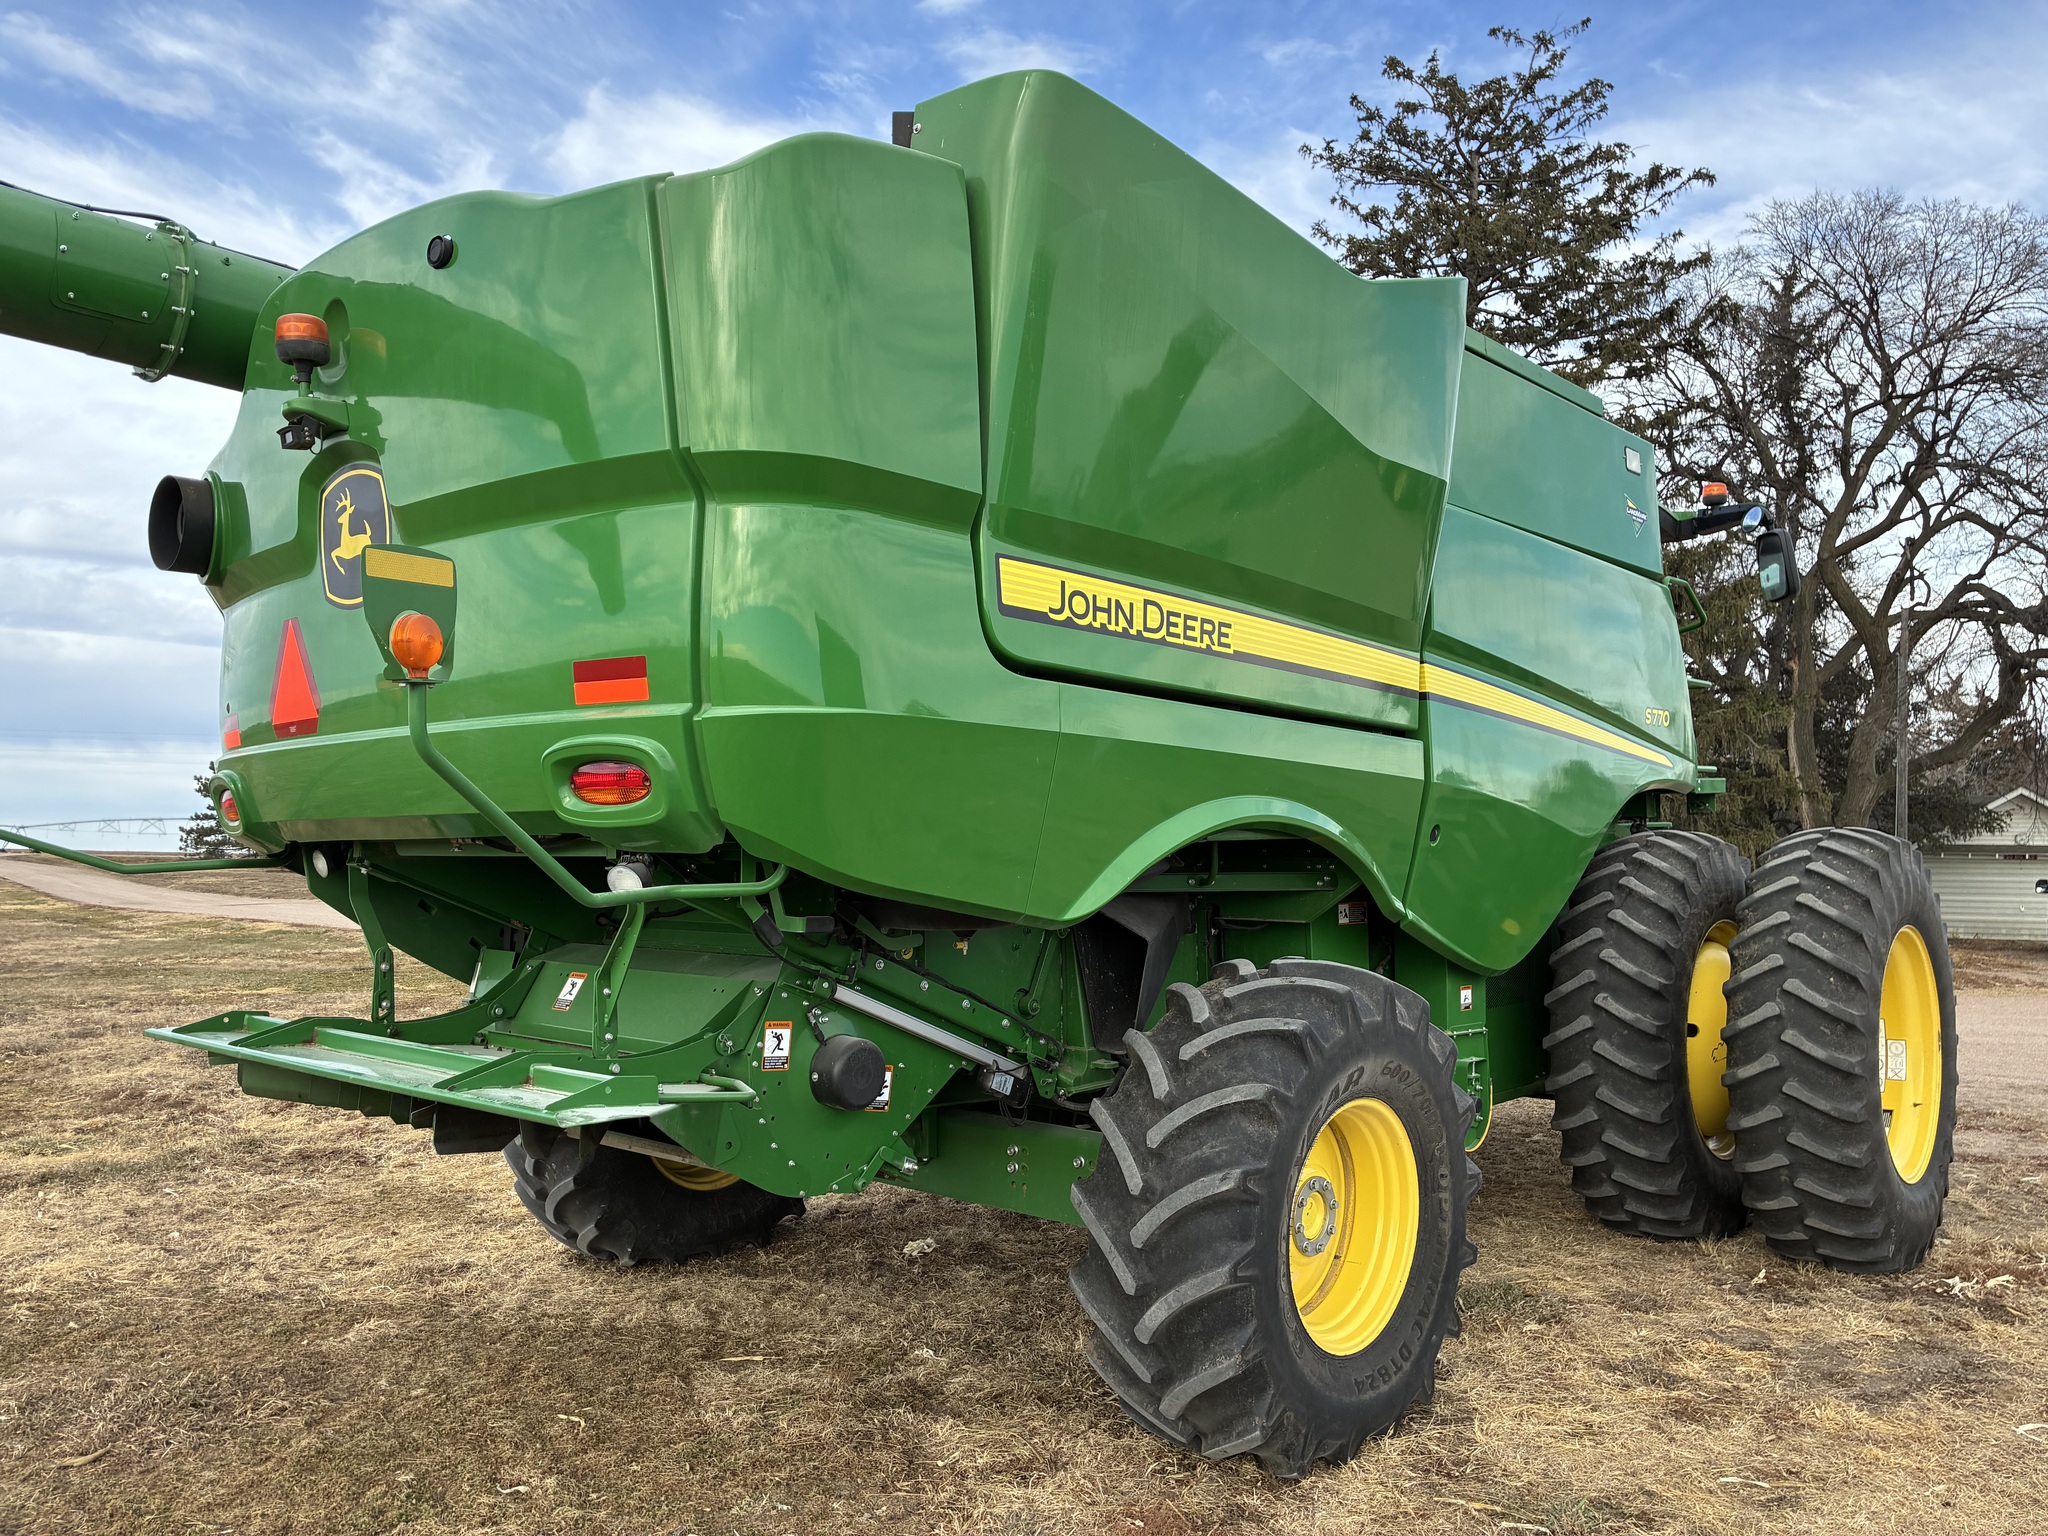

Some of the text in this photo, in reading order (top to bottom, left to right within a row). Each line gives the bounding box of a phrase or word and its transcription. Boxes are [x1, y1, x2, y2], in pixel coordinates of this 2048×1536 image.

[1048, 579, 1233, 651] JOHN DEERE
[1645, 707, 1670, 727] S770
[1353, 1340, 1413, 1397] DT824
